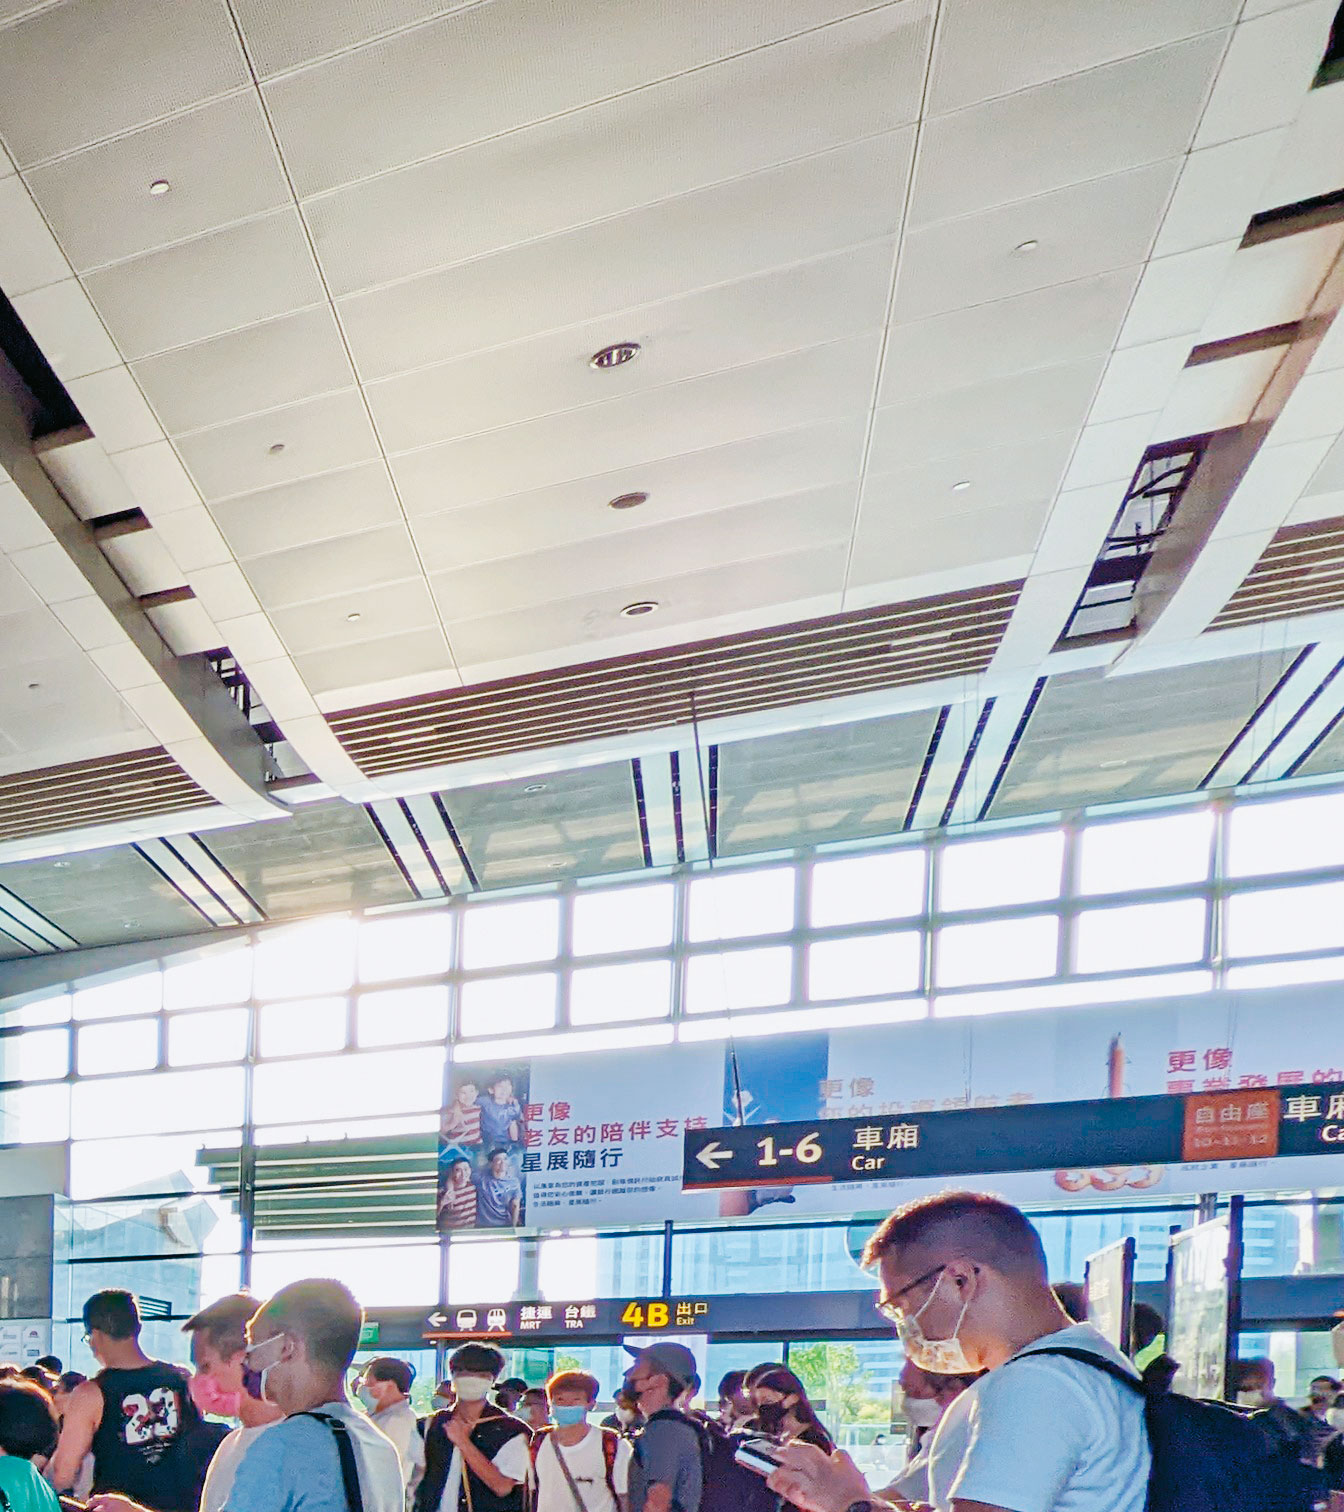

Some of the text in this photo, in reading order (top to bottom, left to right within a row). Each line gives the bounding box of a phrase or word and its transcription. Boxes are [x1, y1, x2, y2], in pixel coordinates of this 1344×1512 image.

[1166, 1047, 1234, 1074] 更像
[819, 1077, 875, 1100] 更像
[522, 1101, 571, 1123] 更像
[1195, 1100, 1270, 1124] 自由座
[522, 1115, 708, 1148] 老友的陪伴支持
[756, 1122, 920, 1167] 1-6 車廂
[520, 1147, 624, 1173] 星展隨行
[851, 1155, 886, 1171] Car
[520, 1304, 553, 1320] 捷運
[564, 1304, 596, 1320] 台鐵
[621, 1301, 709, 1329] 4B 出口
[676, 1316, 696, 1327] Exit
[520, 1319, 542, 1330] MRT
[564, 1319, 583, 1330] TRA
